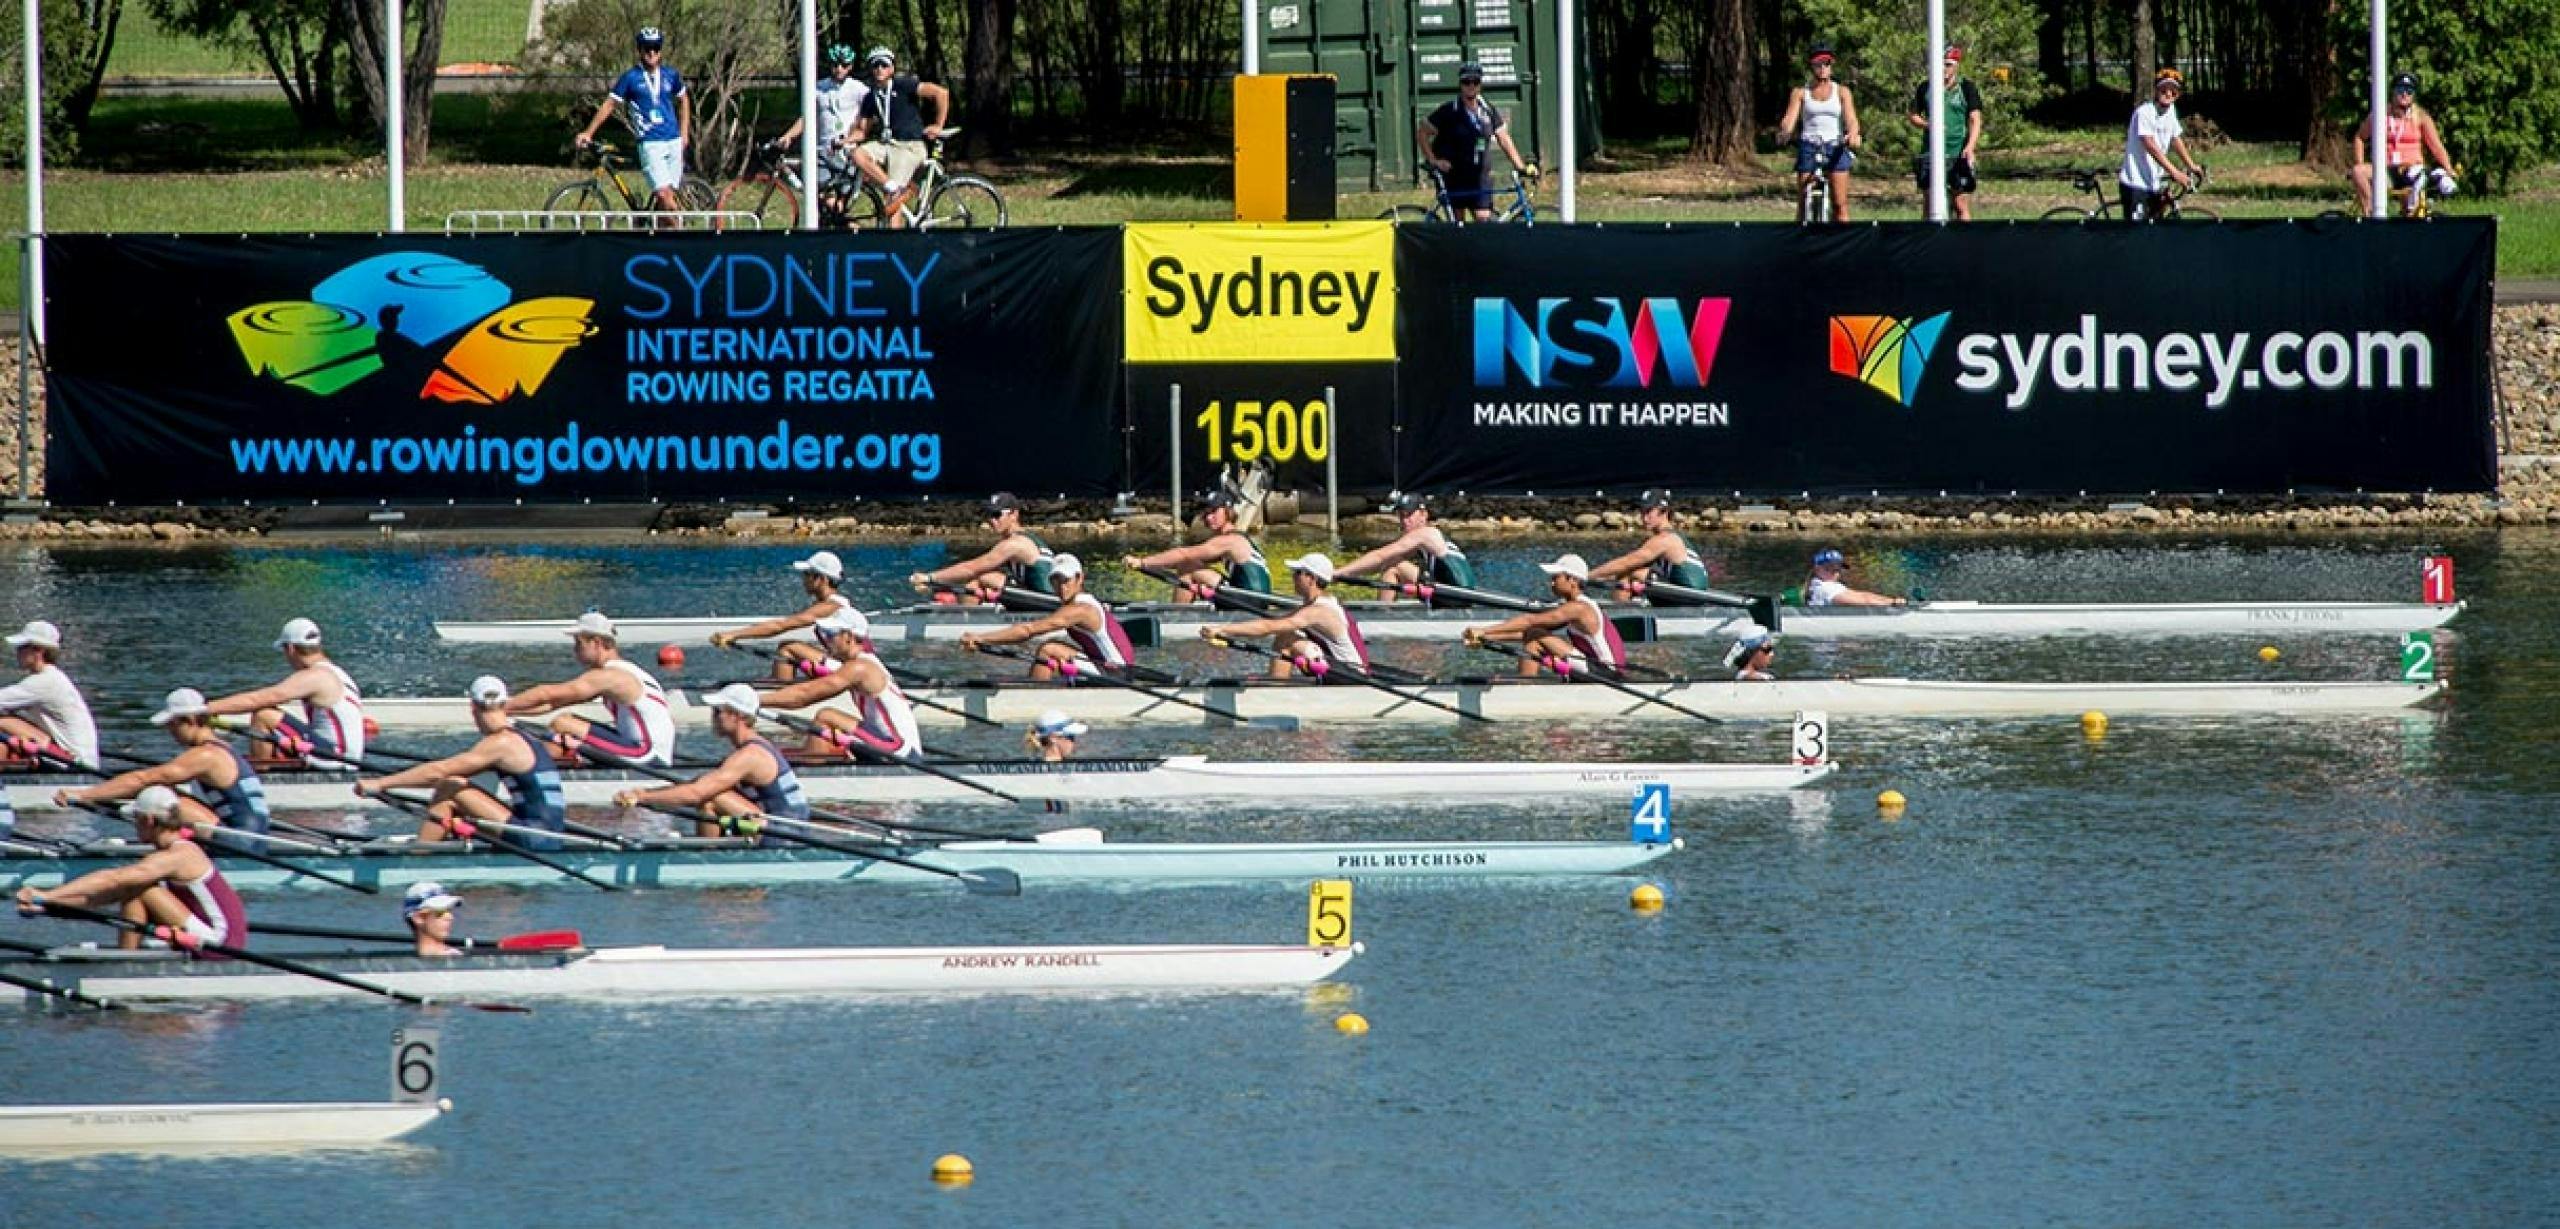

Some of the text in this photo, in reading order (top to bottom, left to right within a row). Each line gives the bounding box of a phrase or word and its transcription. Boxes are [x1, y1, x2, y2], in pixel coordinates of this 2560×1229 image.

[624, 252, 940, 318] SYDNEY
[1146, 256, 1380, 334] Sydney
[627, 326, 934, 362] INTERNATIONAL
[1474, 297, 1731, 388] NSW
[1956, 314, 2432, 408] sydney.com
[627, 369, 935, 403] ROWING REGATTA
[1198, 400, 1328, 462] 1500
[1474, 402, 1728, 426] MAKING IT HAPPEN
[230, 420, 942, 485] www.rowingdownunder.org
[2428, 565, 2444, 600] 1
[2404, 640, 2433, 680] 2
[1797, 721, 1824, 759] 3
[1633, 790, 1667, 835] 4
[1338, 853, 1488, 867] PHIL HUTCHISON
[1316, 895, 1347, 941] 5
[943, 952, 1102, 968] ANDREW RANDELL
[399, 1041, 434, 1094] 6
